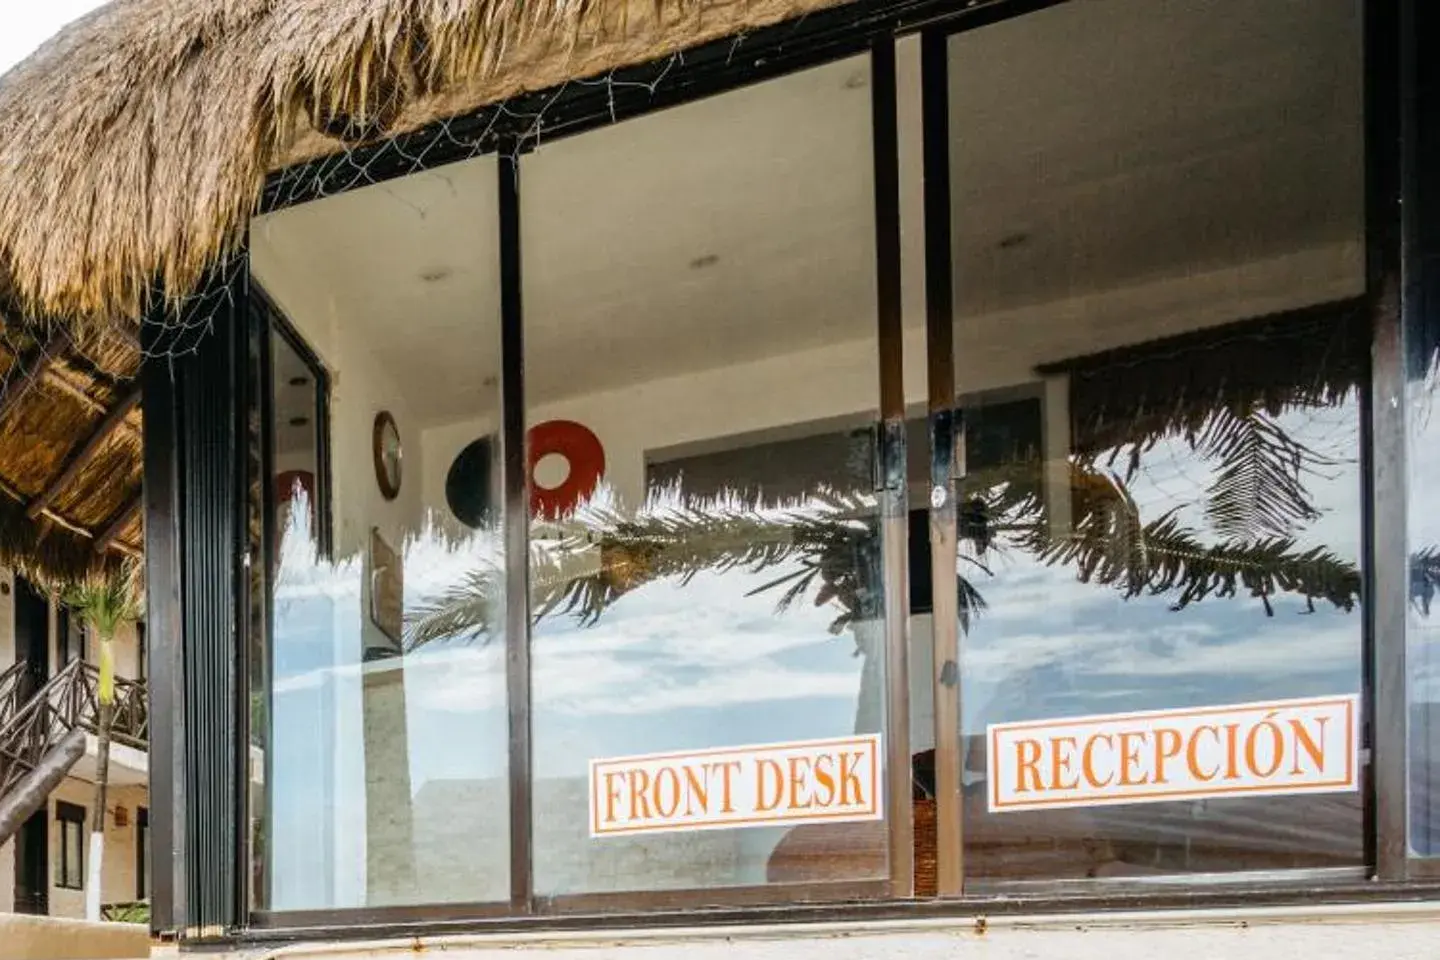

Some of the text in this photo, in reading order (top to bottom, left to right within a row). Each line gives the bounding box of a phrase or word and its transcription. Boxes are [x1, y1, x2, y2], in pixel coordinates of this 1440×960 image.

[603, 751, 868, 824] FRONT DESK
[1015, 711, 1331, 793] RECEPCIÓN
